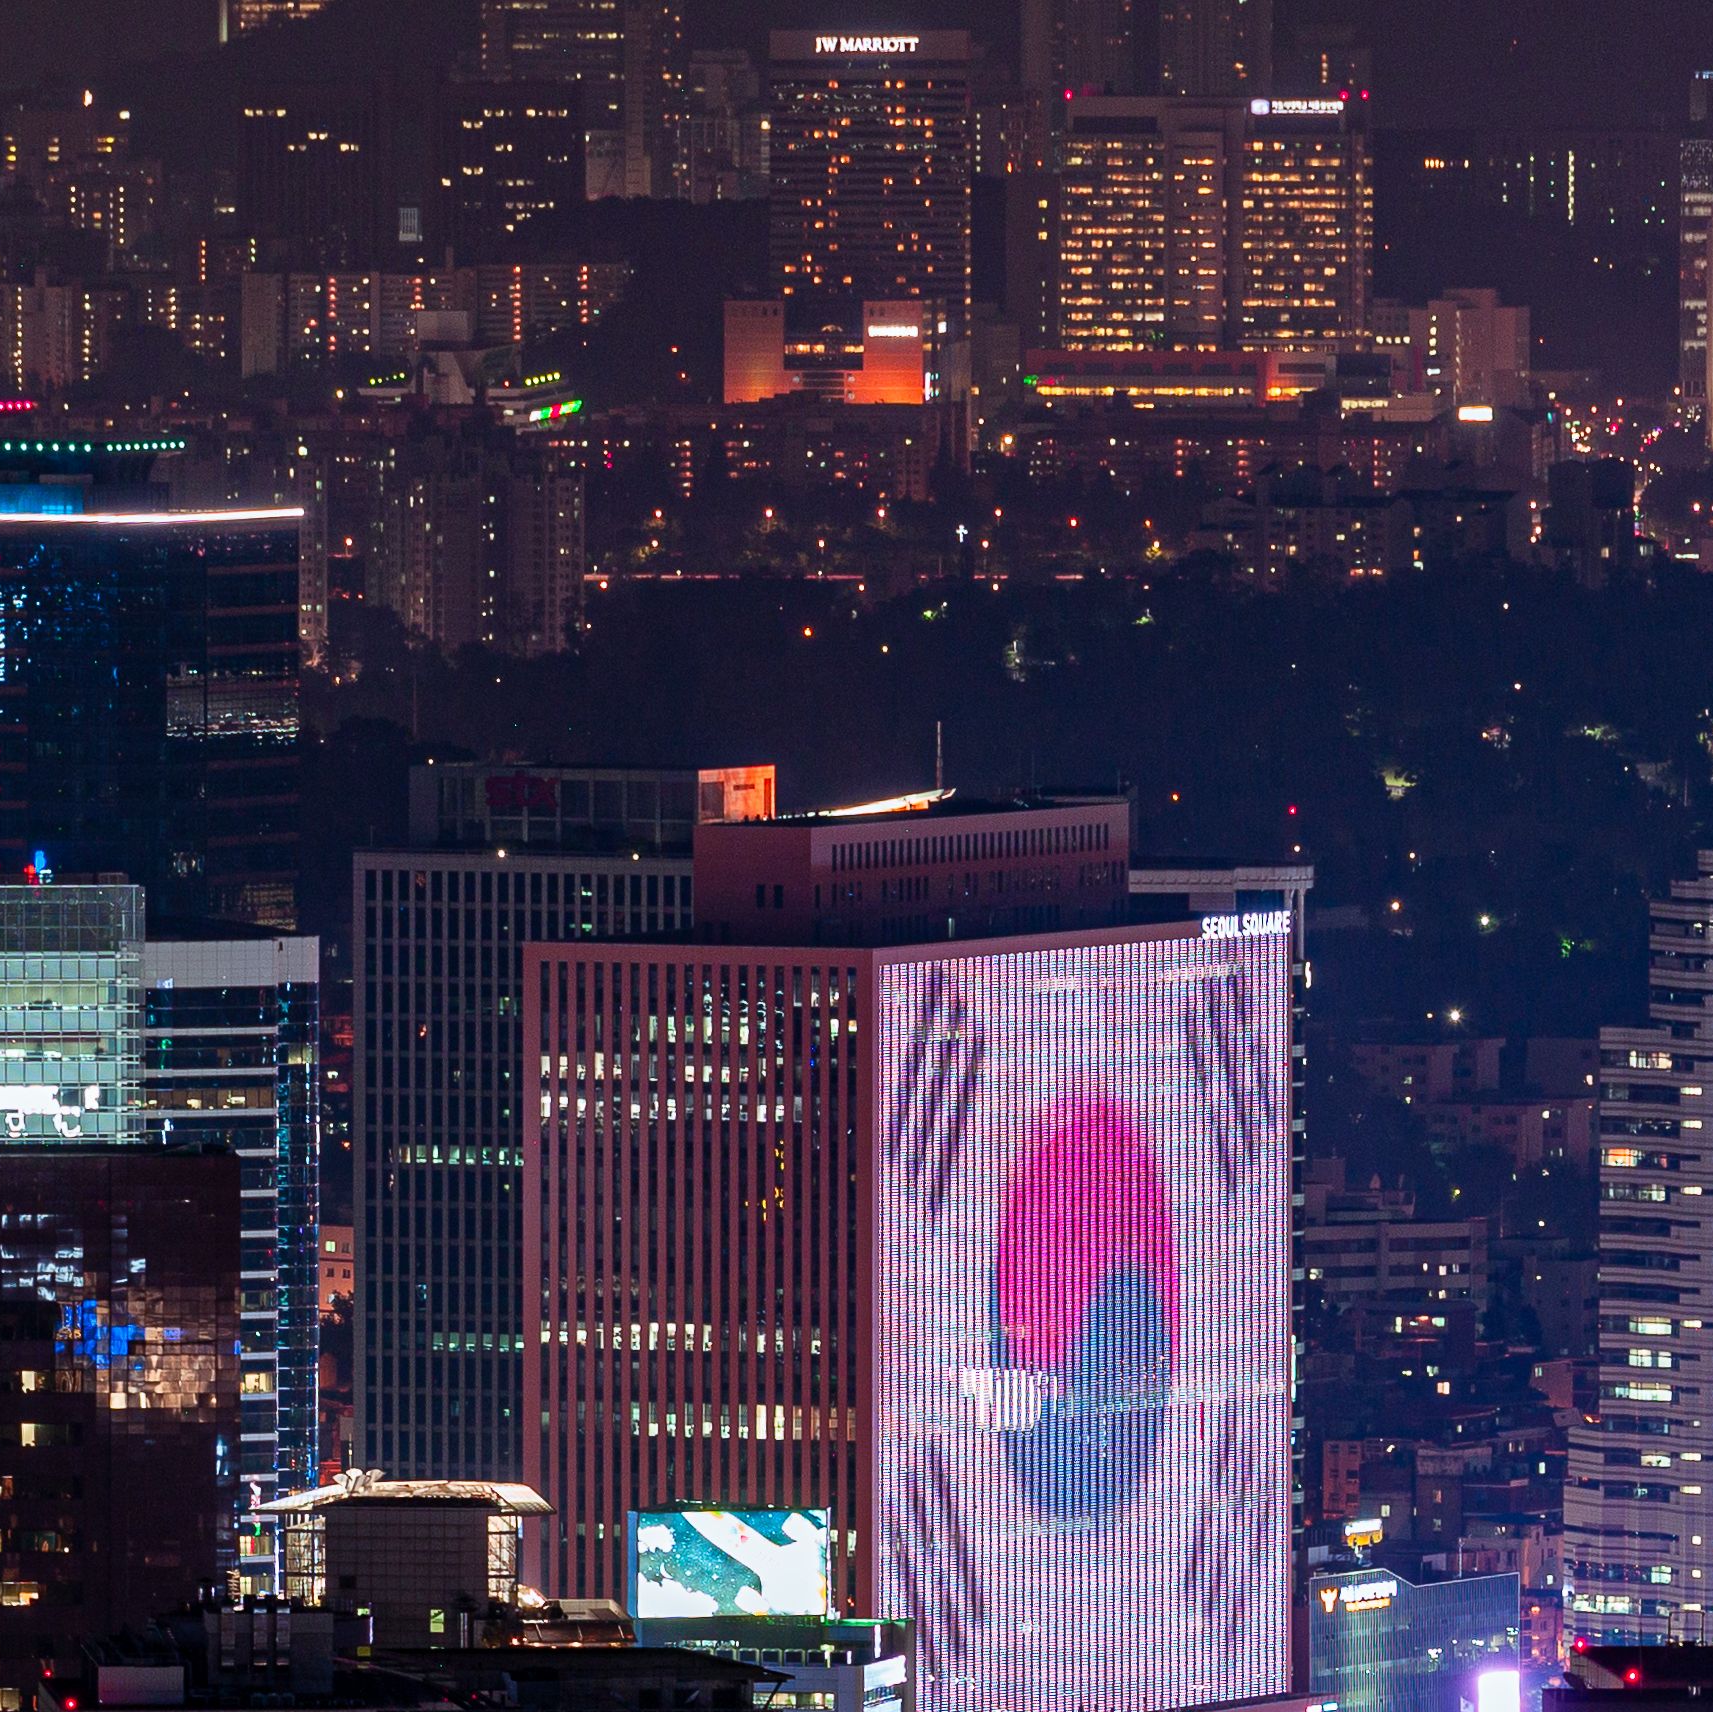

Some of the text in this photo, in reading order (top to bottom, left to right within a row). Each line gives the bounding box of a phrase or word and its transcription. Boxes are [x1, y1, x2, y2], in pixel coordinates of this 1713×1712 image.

[815, 36, 920, 54] JW MARRIOTT
[1201, 910, 1291, 939] SEOUL SQUARE
